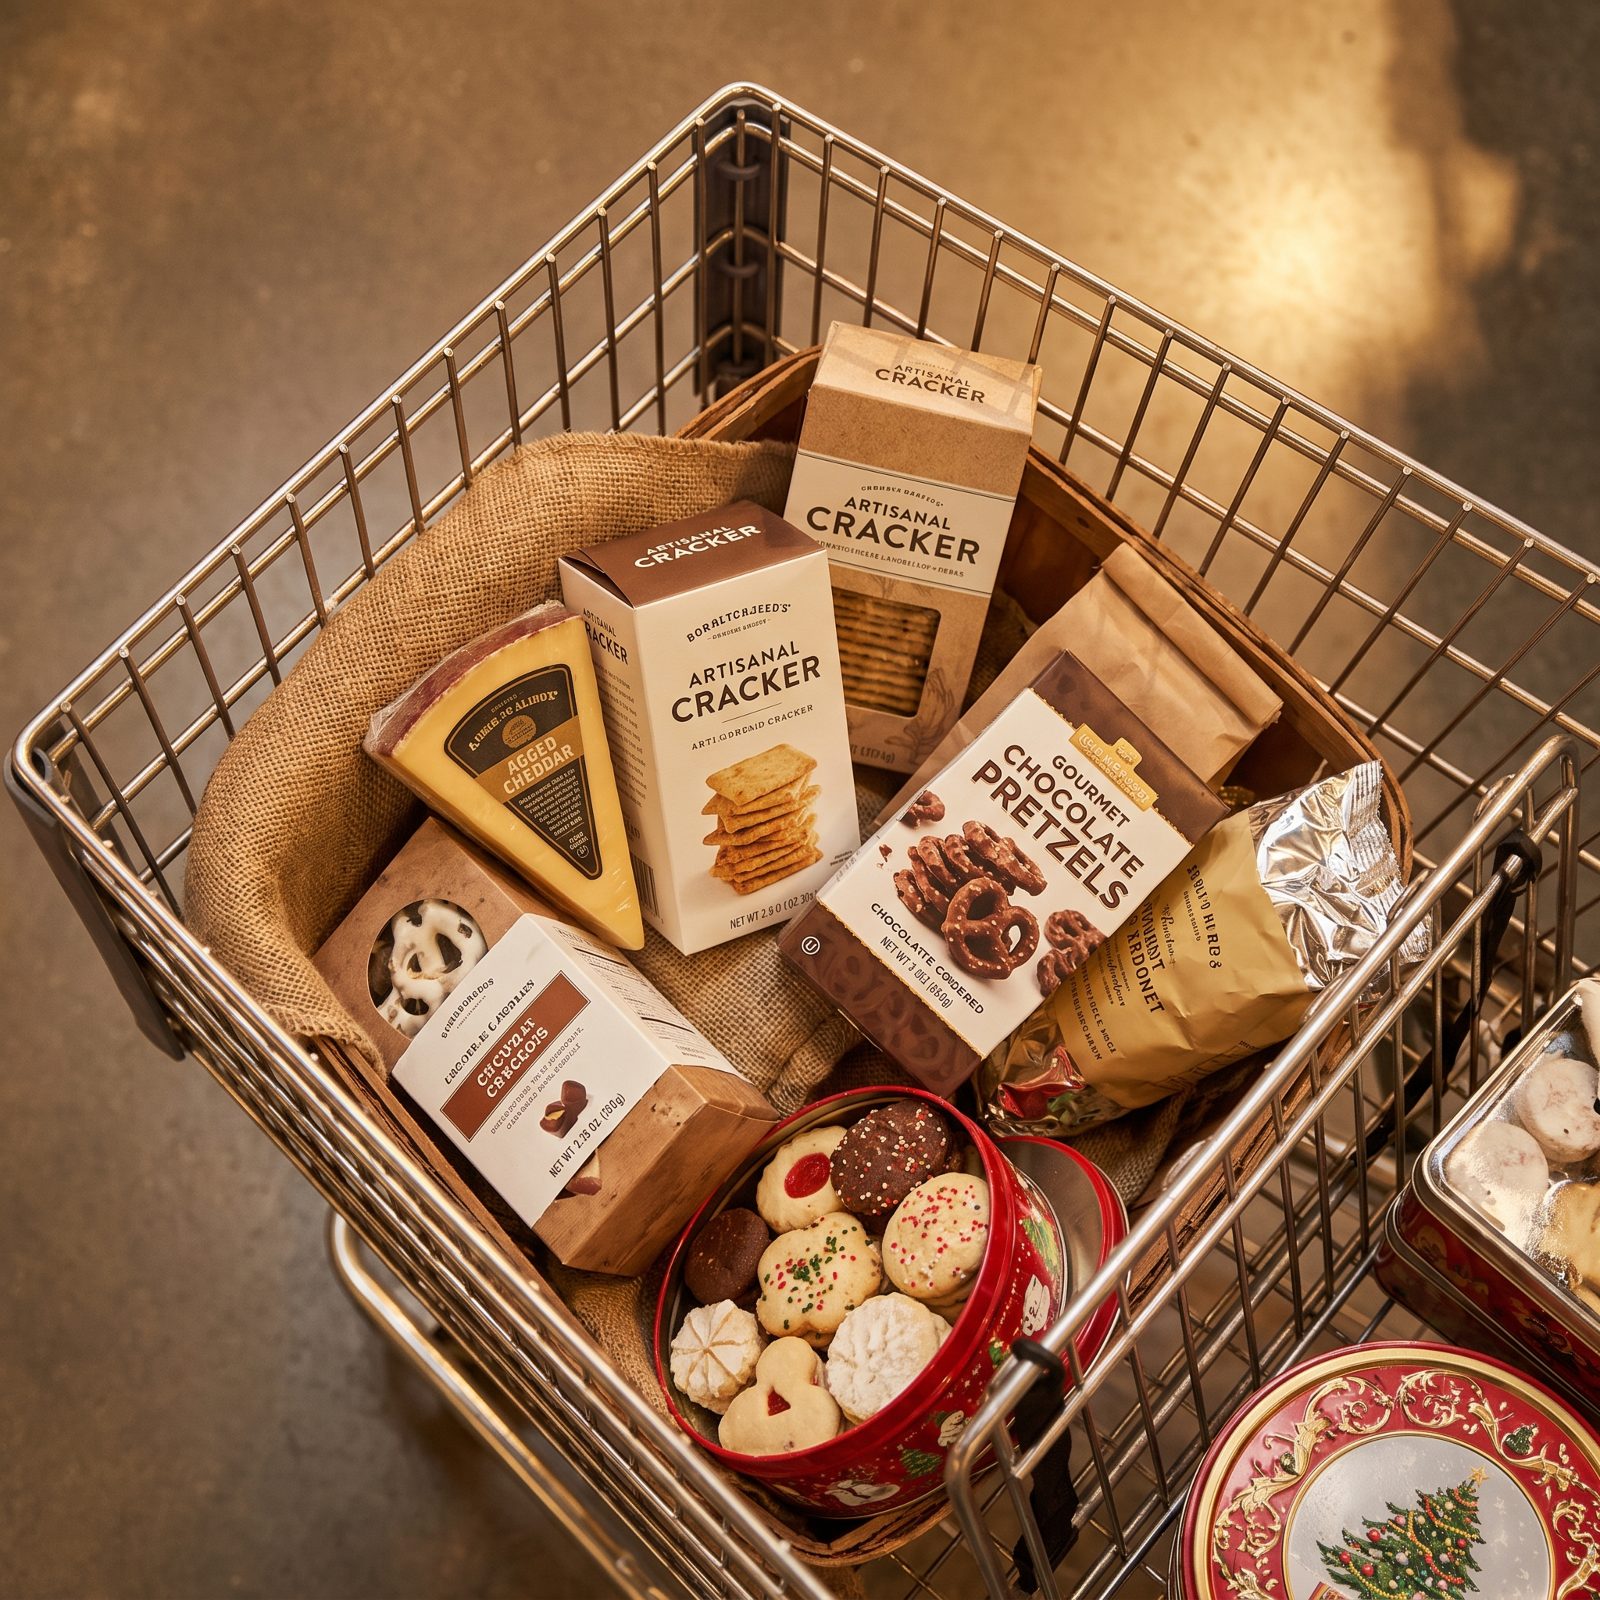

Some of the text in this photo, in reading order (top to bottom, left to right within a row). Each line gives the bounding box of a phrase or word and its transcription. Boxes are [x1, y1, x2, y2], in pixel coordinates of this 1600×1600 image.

[875, 367, 985, 404] CRACKER
[894, 364, 971, 387] ARTISANAL
[844, 496, 951, 530] ARTISANAL
[634, 525, 761, 569] CRACKER
[647, 525, 732, 556] ARTISANAL
[806, 506, 980, 565] CRACKER
[585, 621, 628, 666] RACKER
[688, 640, 800, 689] ARTISANAL
[671, 655, 821, 723] CRACKER
[767, 704, 814, 726] CRACKER
[503, 744, 575, 795] CHEDDAR
[508, 736, 557, 775] AGGED
[1003, 744, 1145, 879] CHOCOLATE
[1052, 755, 1131, 828] GOURMET
[971, 759, 1129, 909] PRETZELS
[730, 913, 746, 930] NET
[746, 911, 760, 925] WT
[879, 936, 897, 954] NET
[894, 949, 911, 967] WT
[549, 1159, 566, 1179] NET
[561, 1144, 577, 1164] WT
